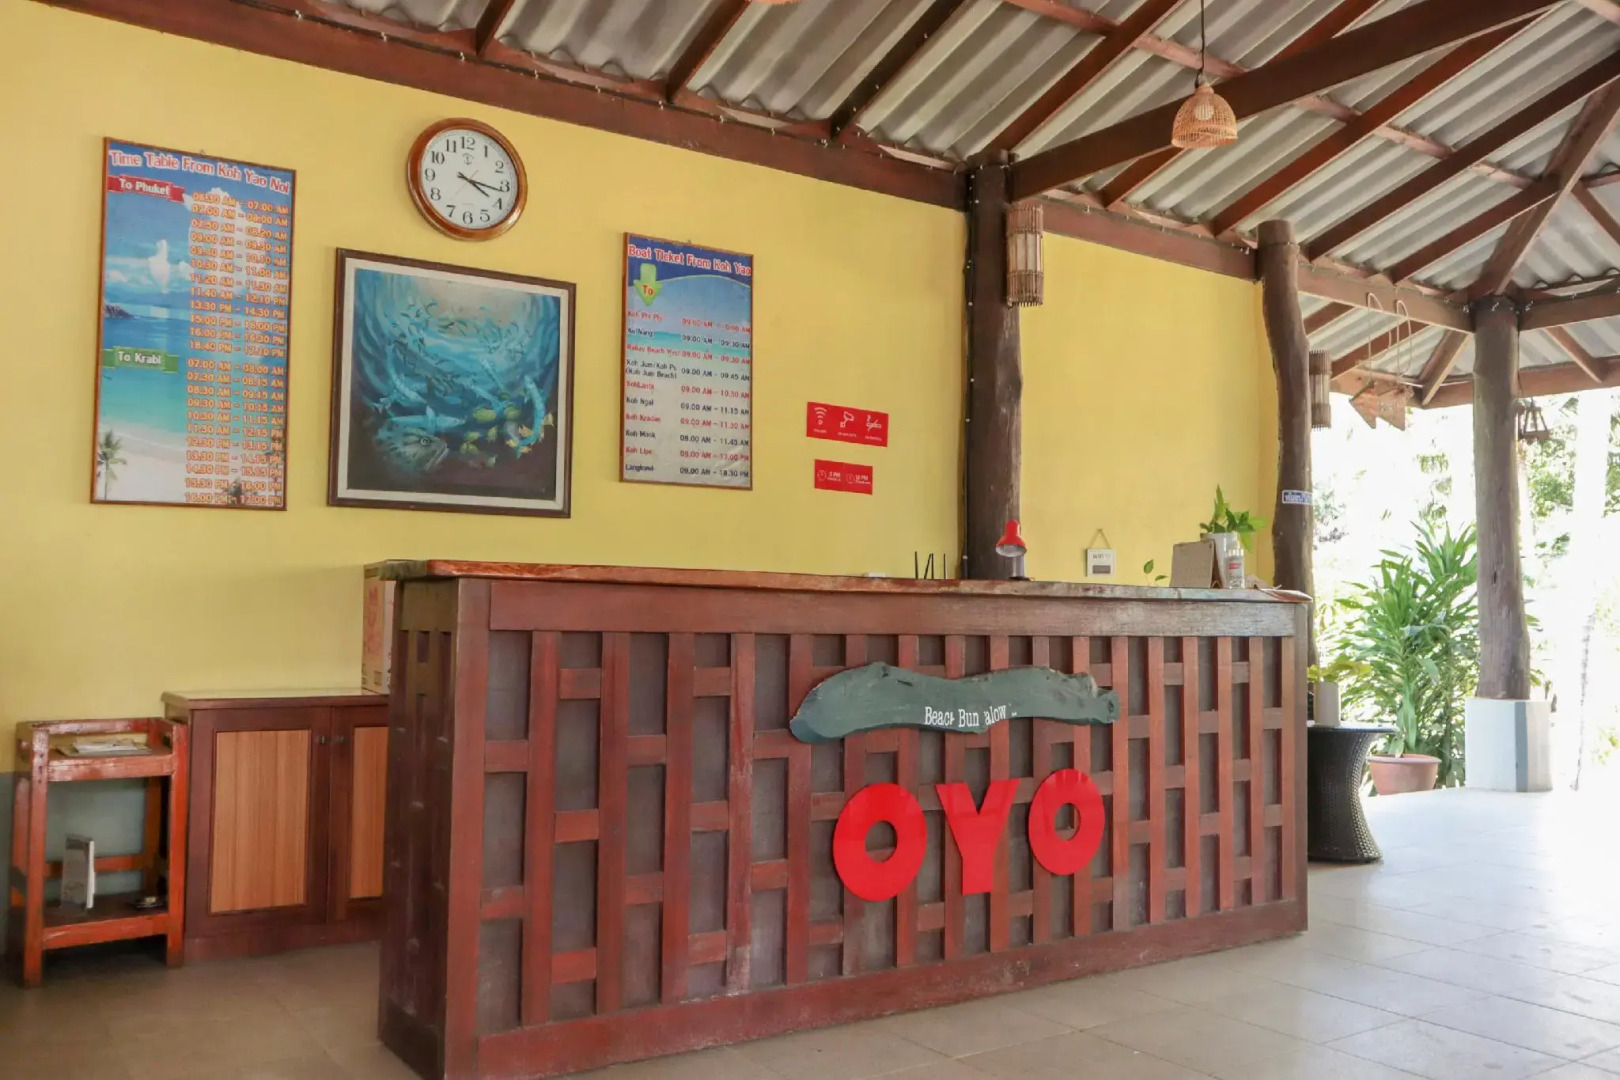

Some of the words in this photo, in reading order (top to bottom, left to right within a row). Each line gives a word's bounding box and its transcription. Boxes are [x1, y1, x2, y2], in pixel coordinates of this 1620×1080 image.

[446, 139, 456, 152] 11
[461, 137, 475, 150] 12
[431, 151, 445, 164] 10
[484, 145, 488, 158] 1
[109, 150, 141, 169] Time
[143, 152, 178, 170] Table
[181, 156, 214, 175] From
[216, 163, 241, 181] Koh
[243, 170, 266, 187] Yao
[270, 177, 289, 194] Noi
[495, 161, 504, 173] 2
[425, 169, 435, 181] 9
[119, 179, 131, 189] To
[135, 182, 169, 195] Phuket
[500, 181, 510, 192] 3
[431, 188, 441, 201] 8
[275, 204, 289, 214] AM
[493, 198, 502, 210] 4
[446, 205, 455, 217] 7
[463, 211, 473, 224] 6
[480, 210, 490, 222] 5
[275, 216, 288, 227] AM
[628, 244, 651, 259] Boat
[654, 249, 684, 265] Ticket
[686, 254, 710, 269] From
[713, 258, 731, 273] Koh
[733, 262, 751, 276] Yao
[273, 269, 287, 279] AM
[642, 284, 653, 295] To
[219, 290, 232, 300] AM
[273, 296, 286, 306] PM
[219, 303, 232, 314] PM
[272, 309, 285, 319] PM
[272, 335, 285, 345] PM
[117, 352, 130, 361] To
[134, 353, 161, 364] Krabi
[271, 348, 285, 358] PM
[187, 359, 215, 370] 07.00
[217, 361, 231, 371] AM
[271, 366, 284, 376] AM
[217, 375, 231, 384] AM
[270, 379, 284, 388] AM
[217, 387, 231, 397] AM
[270, 392, 284, 401] AM
[217, 400, 231, 410] AM
[271, 404, 284, 413] AM
[217, 413, 231, 422] AM
[271, 417, 284, 426] AM
[216, 425, 230, 435] AM
[270, 429, 284, 438] PM
[270, 442, 282, 451] PM
[833, 768, 1105, 901] OYO
